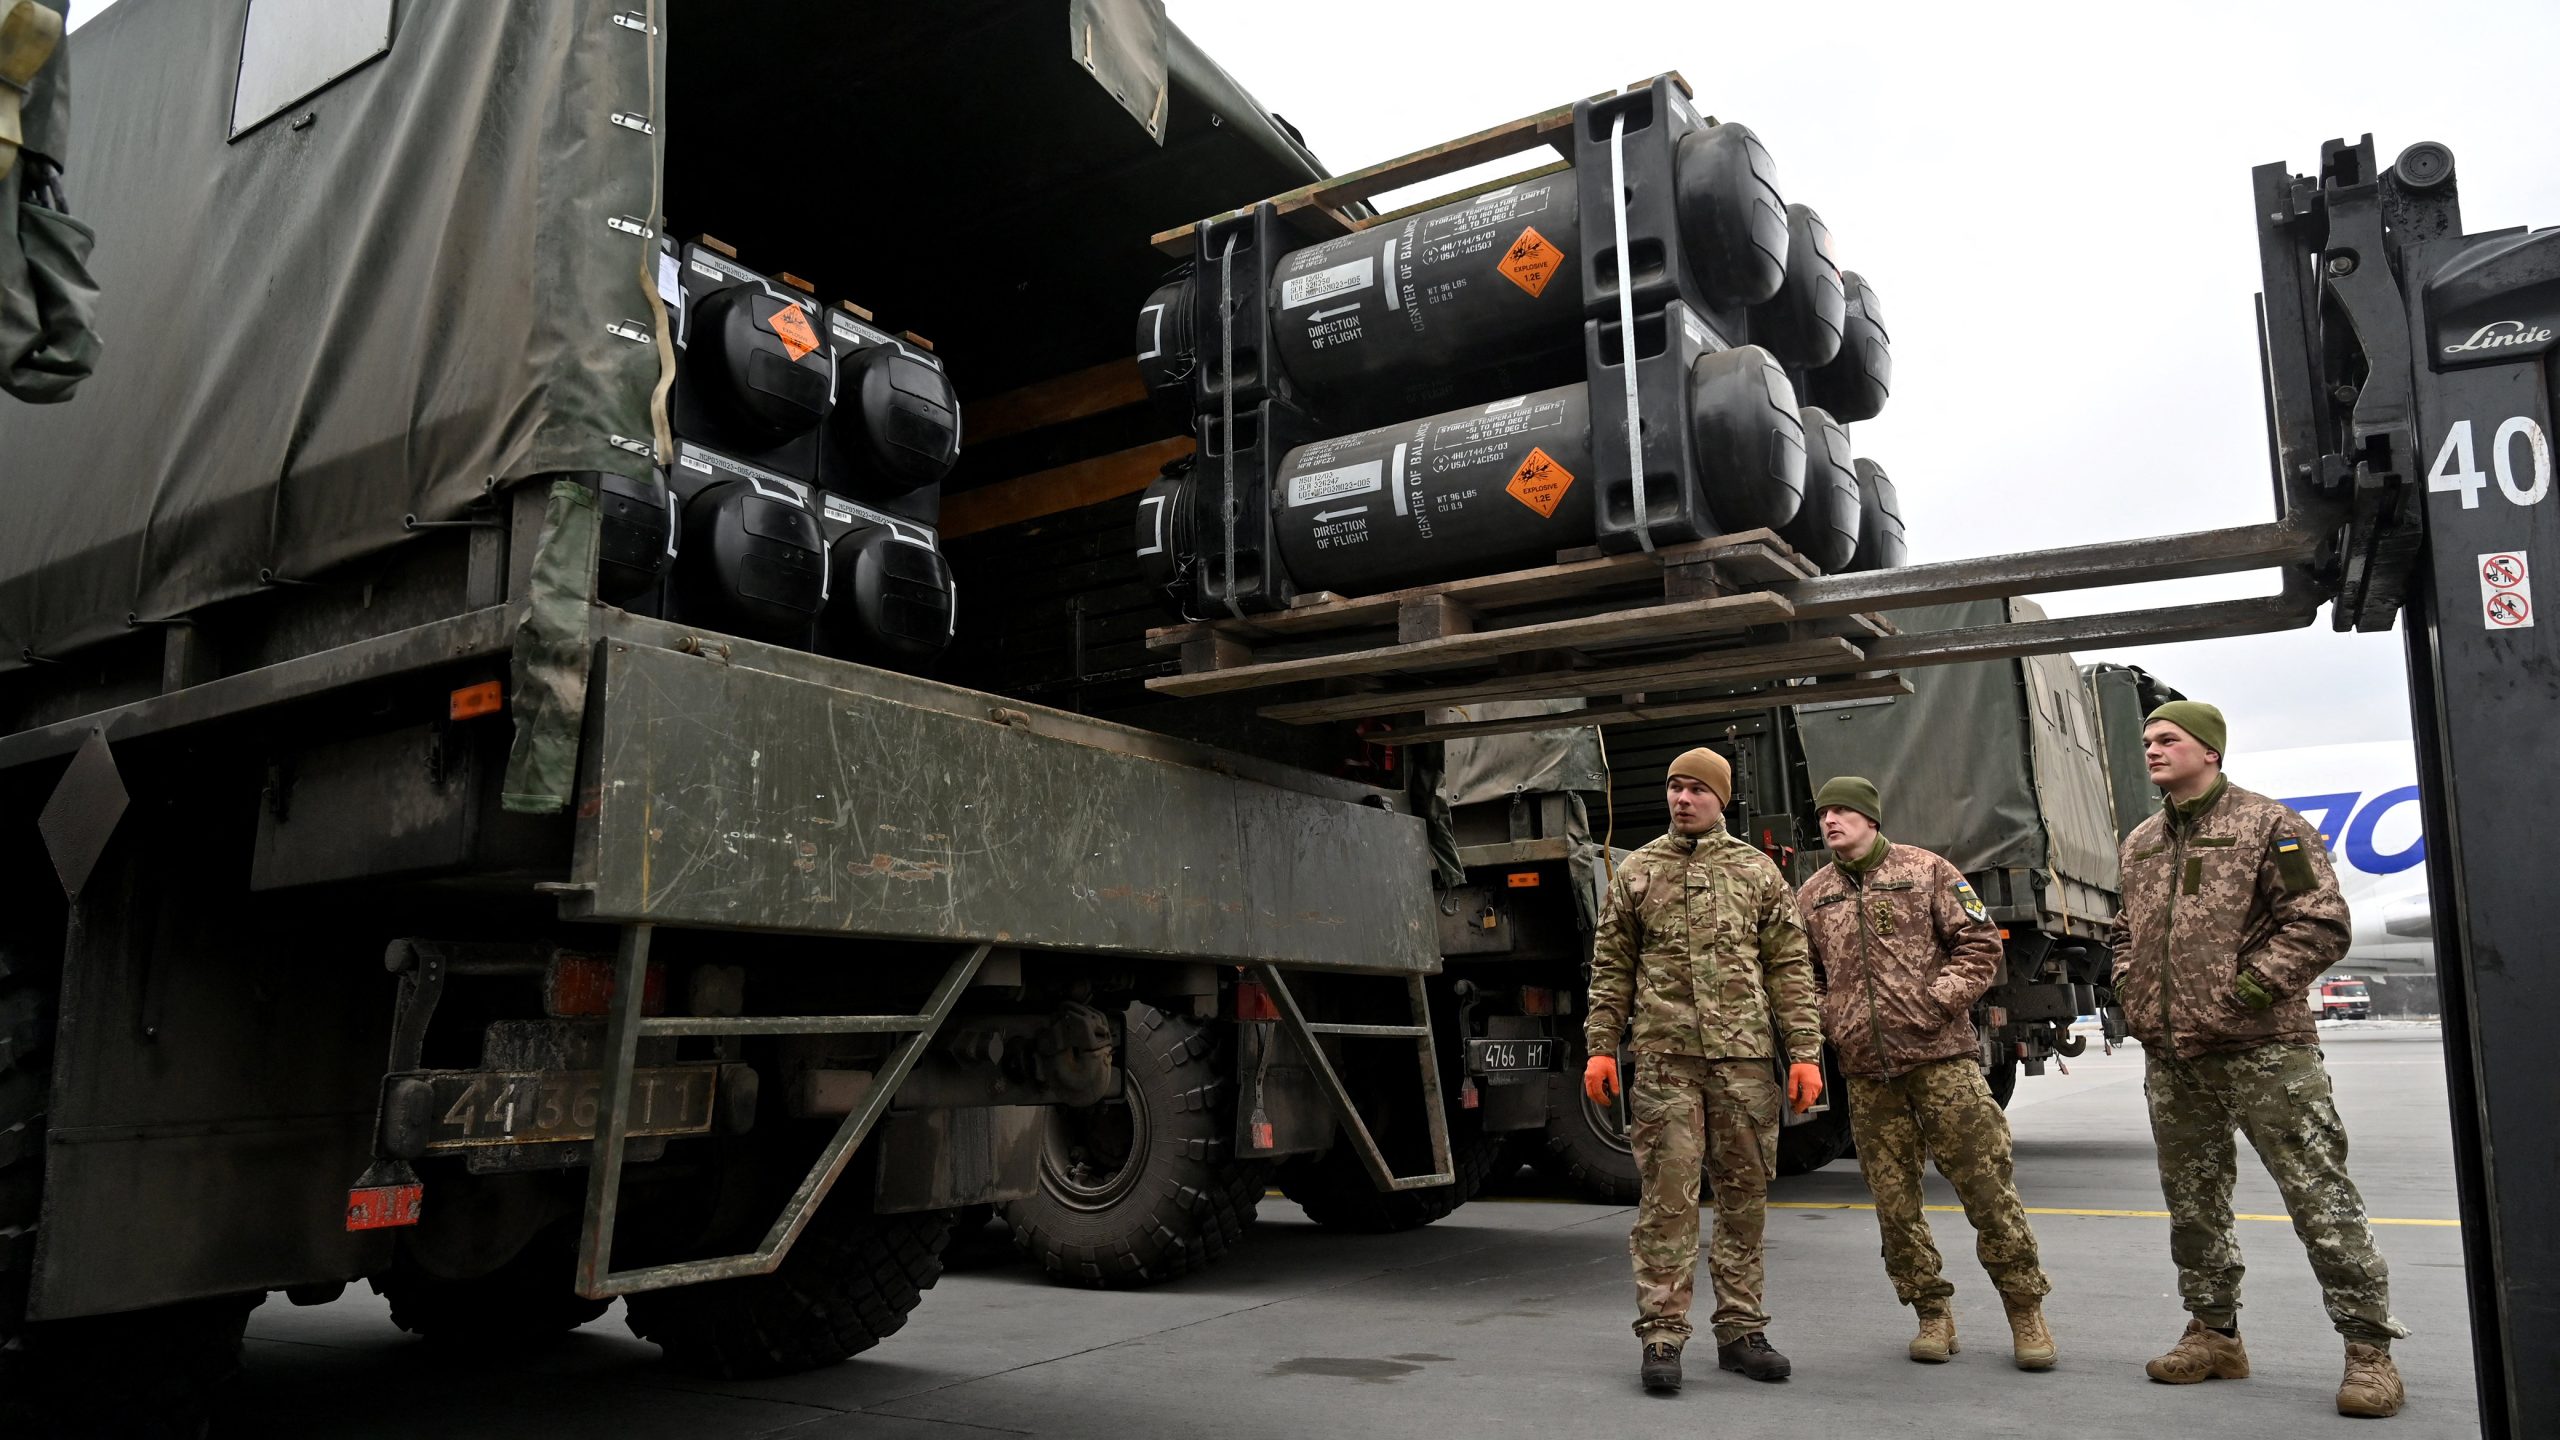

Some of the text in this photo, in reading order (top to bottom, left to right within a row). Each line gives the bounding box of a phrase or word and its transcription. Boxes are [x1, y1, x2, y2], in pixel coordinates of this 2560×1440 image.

[1430, 213, 1462, 227] STORAGE
[1465, 196, 1518, 216] TEMPERATURE
[1520, 189, 1546, 201] LIMITS
[1468, 214, 1477, 222] TO
[1479, 210, 1492, 220] 160
[1494, 206, 1510, 216] DEG
[1470, 220, 1480, 228] TO
[1492, 213, 1507, 222] DEG
[1400, 217, 1425, 333] CENTER OF BALANCE
[1514, 262, 1548, 272] EXPLOSIVE
[1440, 284, 1450, 292] 96
[1452, 278, 1468, 289] LBS
[1524, 272, 1542, 282] 1.2E
[1429, 294, 1440, 304] CU
[1308, 316, 1360, 338] DIRECTION
[1312, 328, 1364, 350] OF FLIGHT
[2444, 320, 2552, 353] Linde
[1440, 421, 1474, 434] STORAGE
[1478, 408, 1532, 426] TEMPERATURE
[1534, 402, 1560, 412] LIMITS
[1480, 424, 1490, 432] TO
[1492, 420, 1506, 428] 160
[1508, 417, 1523, 426] DEG
[1482, 430, 1492, 438] TO
[1504, 424, 1520, 434] DEG
[2428, 416, 2552, 510] 40
[1298, 483, 1312, 492] SER
[1410, 422, 1433, 540] CENTER OF BALANCE
[1523, 482, 1558, 494] EXPLOSIVE
[1436, 490, 1478, 504] WT 96 LBS
[1534, 494, 1552, 503] 1.2E
[1438, 502, 1463, 513] CU 8.9
[1313, 518, 1366, 538] DIRECTION
[1317, 530, 1369, 550] OF FLIGHT
[1486, 1044, 1543, 1068] 4766 H1
[638, 1079, 690, 1126] T1
